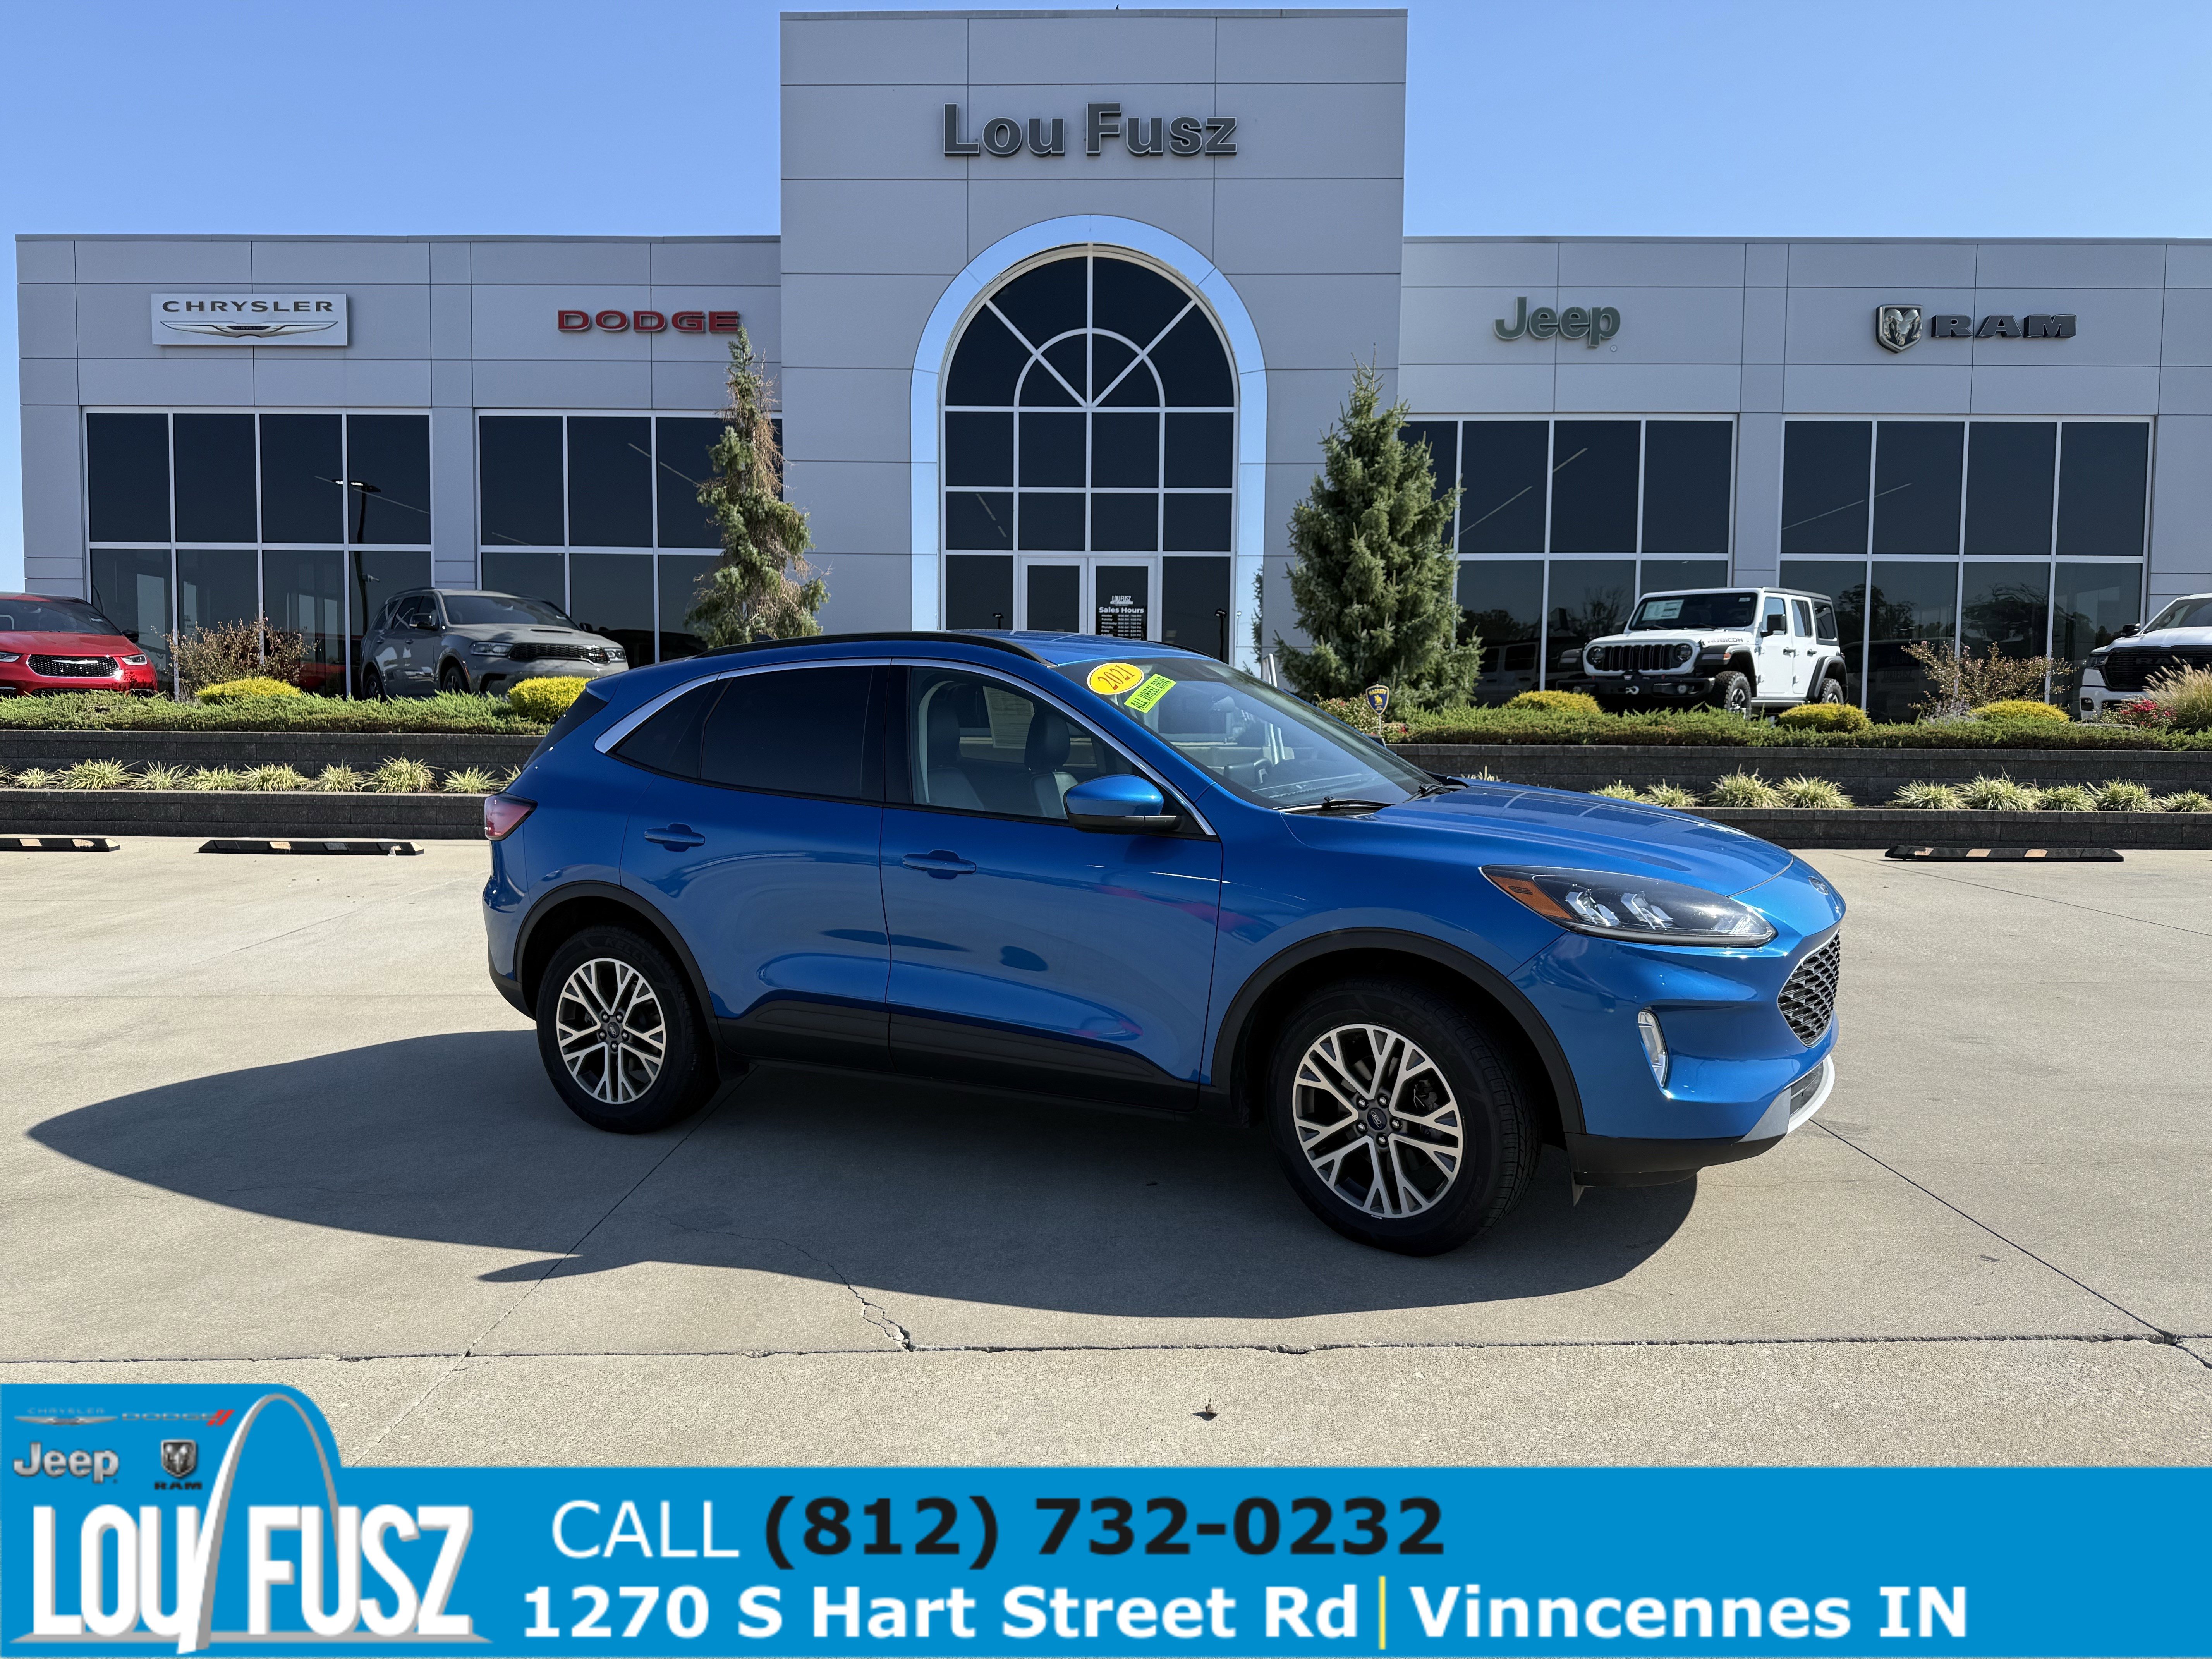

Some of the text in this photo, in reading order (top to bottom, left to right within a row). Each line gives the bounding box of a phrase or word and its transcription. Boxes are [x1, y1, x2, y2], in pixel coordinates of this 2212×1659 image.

[943, 103, 1237, 156] Lou Fusz
[162, 301, 333, 312] CHRYSLER
[558, 310, 739, 332] DODGE
[1494, 296, 1621, 348] Jeep
[1931, 314, 2077, 338] RAM
[1098, 665, 1135, 690] 2021
[1131, 677, 1170, 710] ALL WHEEL DRIVE
[605, 938, 650, 964] KELLY
